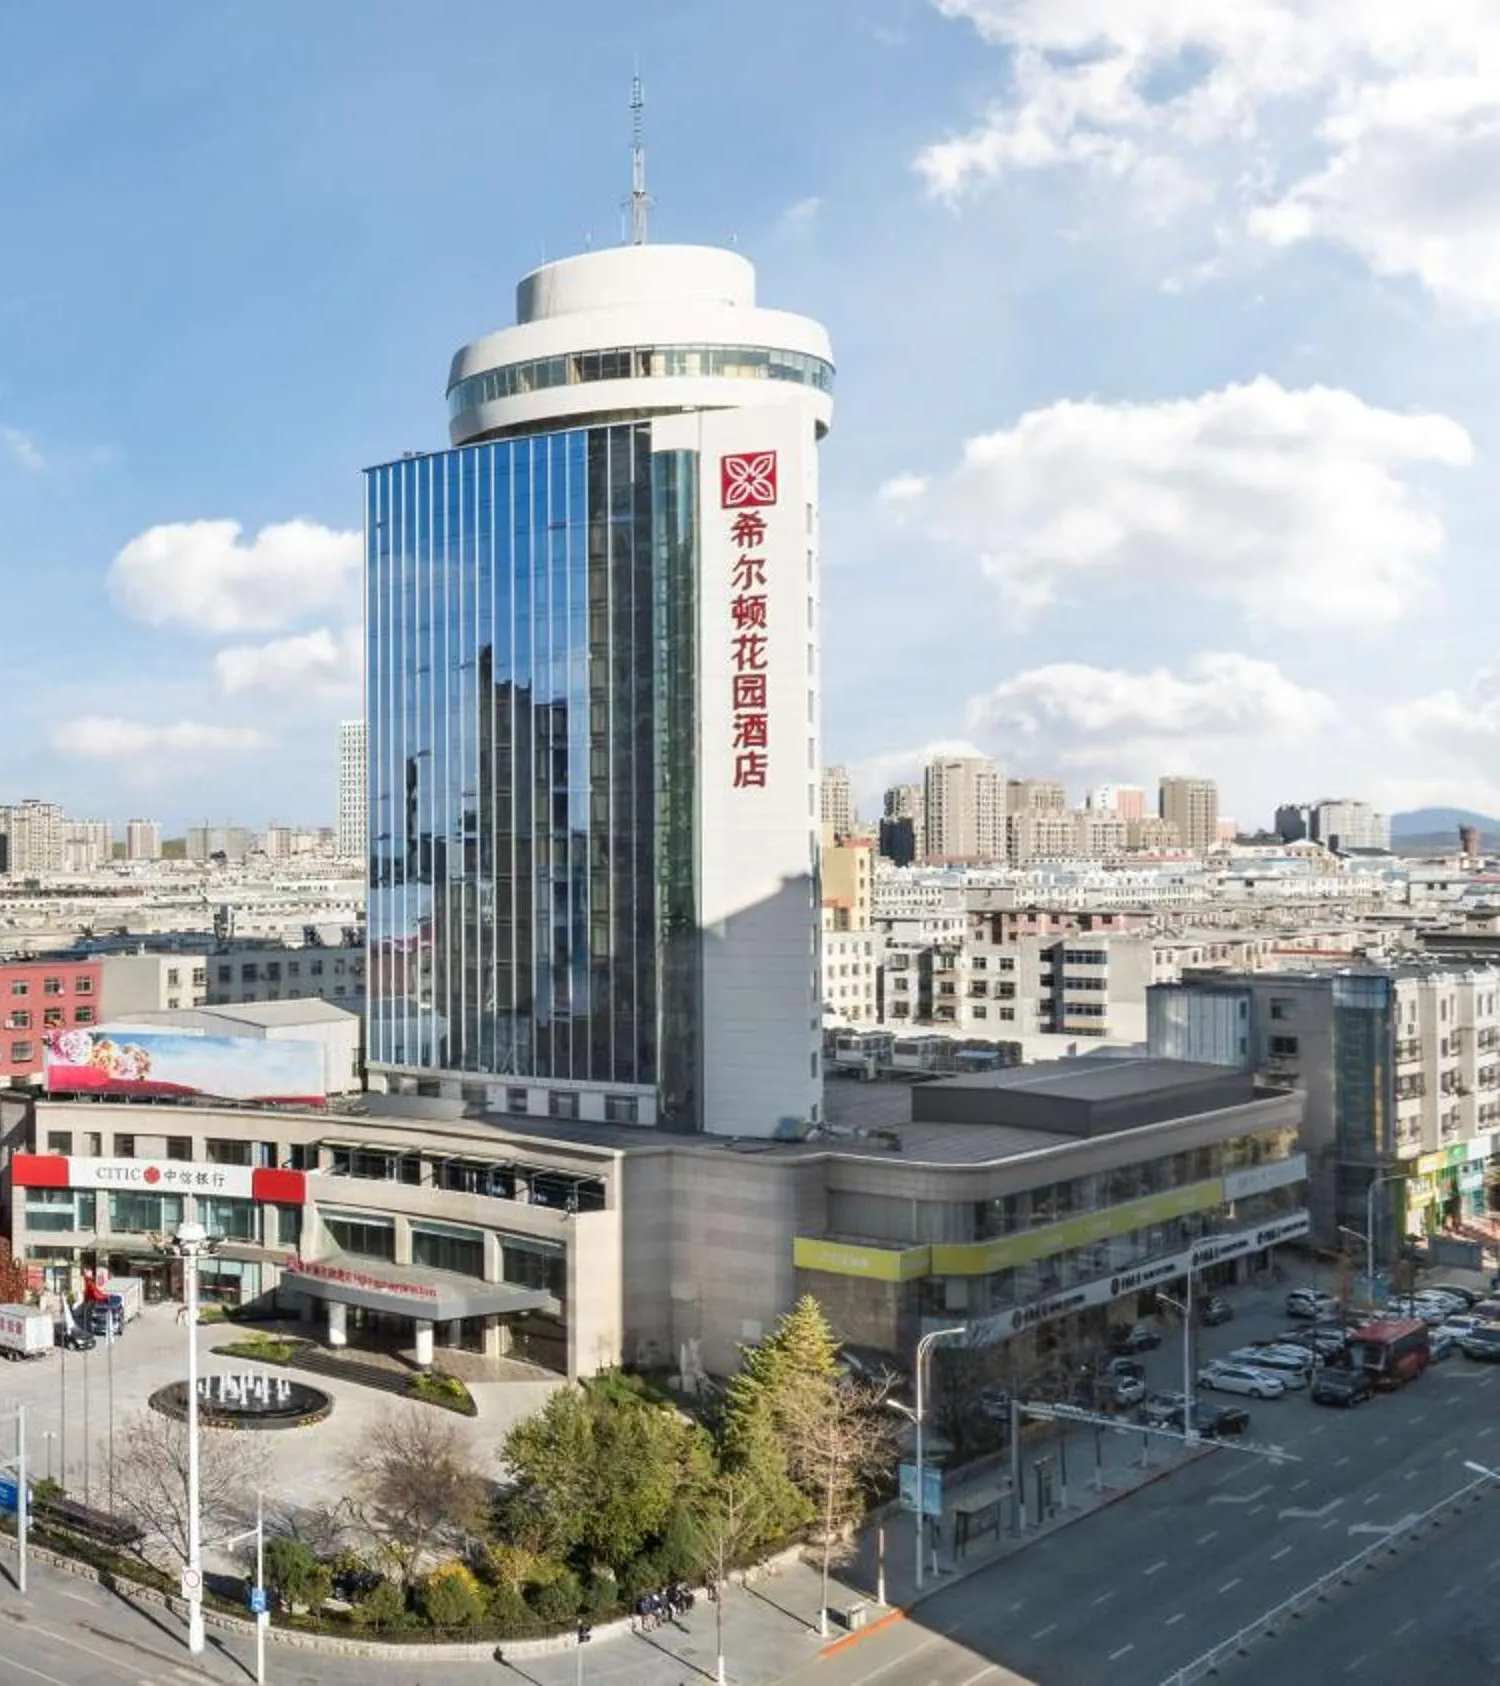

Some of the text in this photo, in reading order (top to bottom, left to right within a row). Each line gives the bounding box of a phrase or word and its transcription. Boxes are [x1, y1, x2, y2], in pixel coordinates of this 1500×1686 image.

[731, 510, 768, 788] 希尔顿花园酒店
[96, 1166, 226, 1188] CITIC 中信银行
